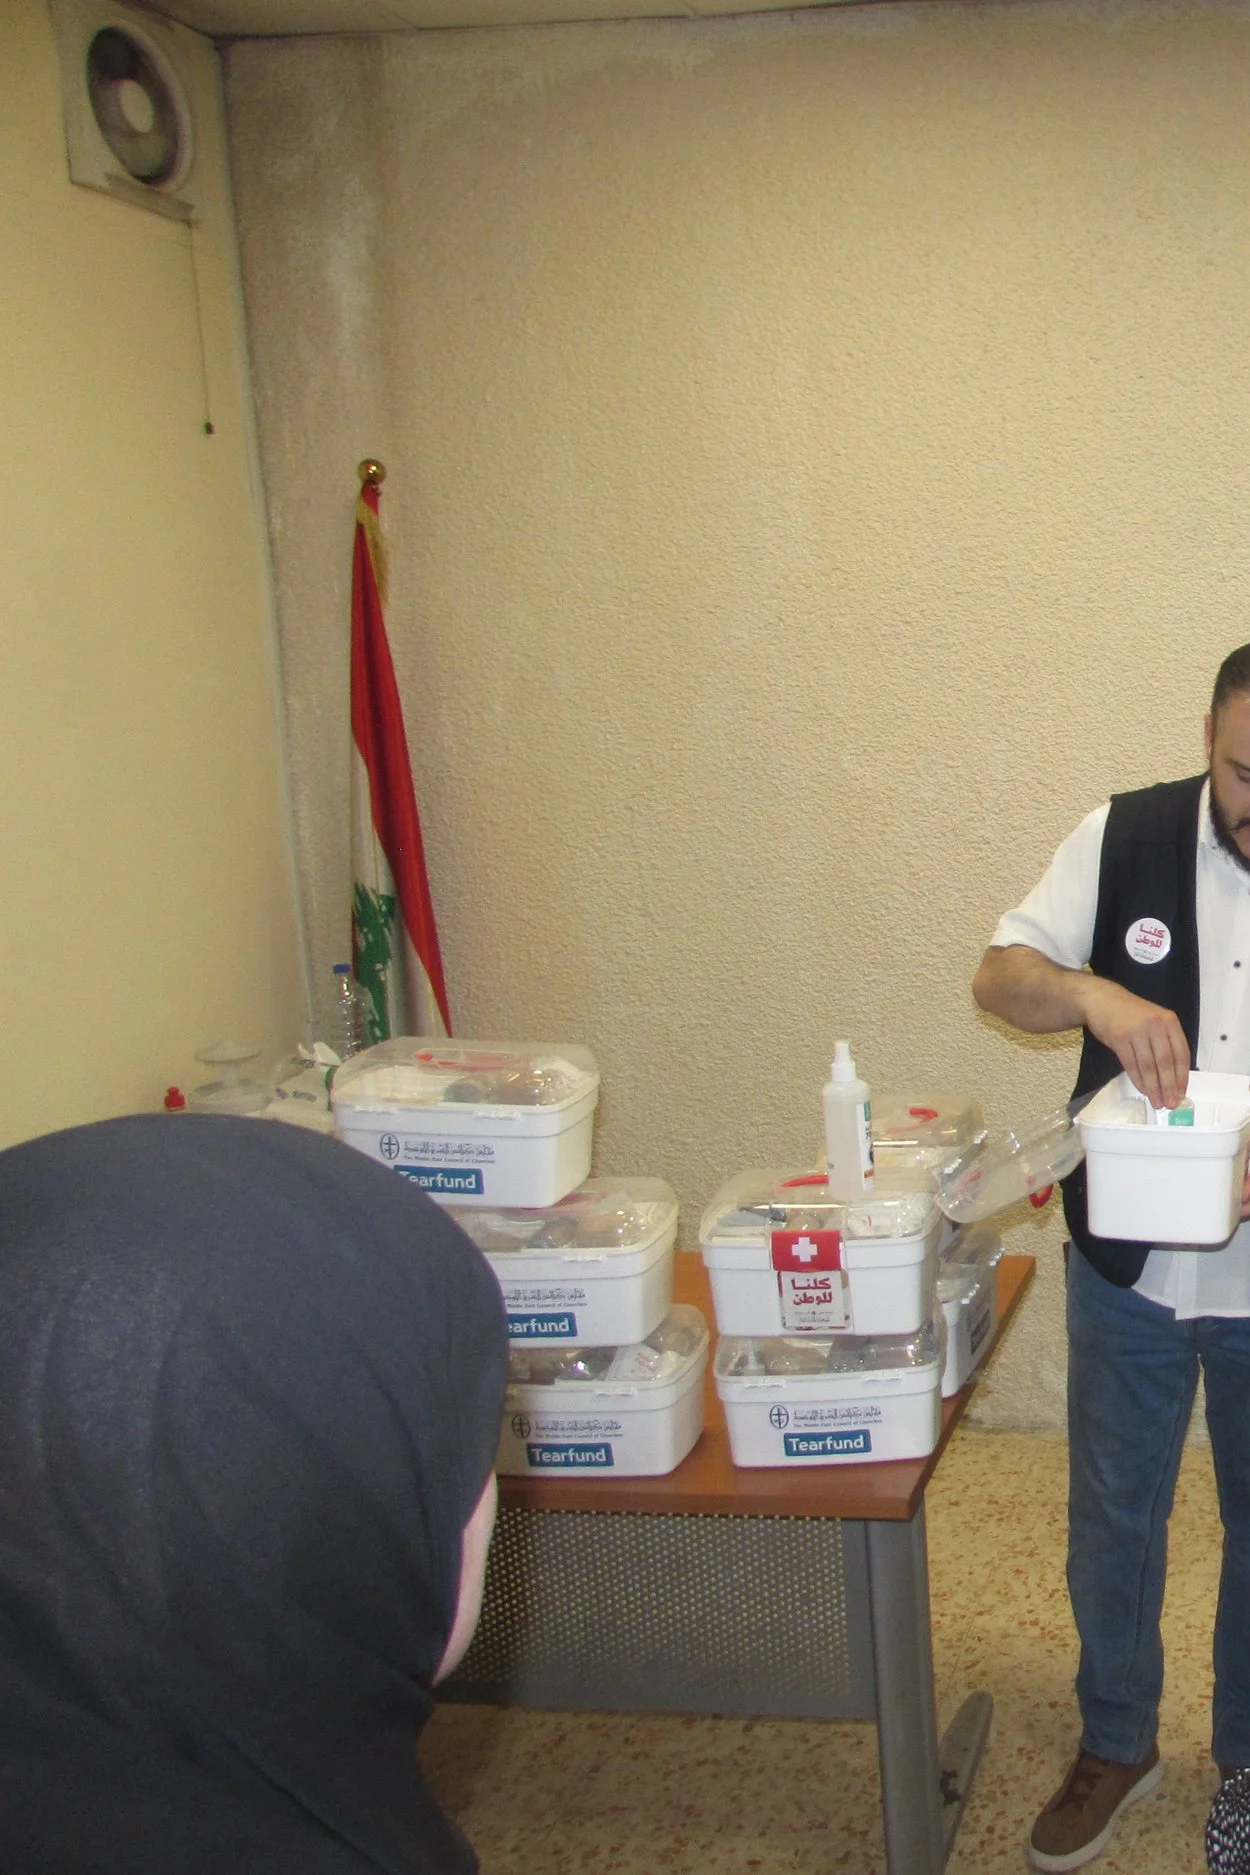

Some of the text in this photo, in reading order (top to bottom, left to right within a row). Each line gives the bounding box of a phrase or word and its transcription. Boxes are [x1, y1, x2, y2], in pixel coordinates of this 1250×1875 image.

[791, 1277, 831, 1290] كلنا
[793, 1291, 832, 1305] للوطن
[788, 1434, 864, 1451] Tearfund
[531, 1448, 606, 1462] Tearfund
